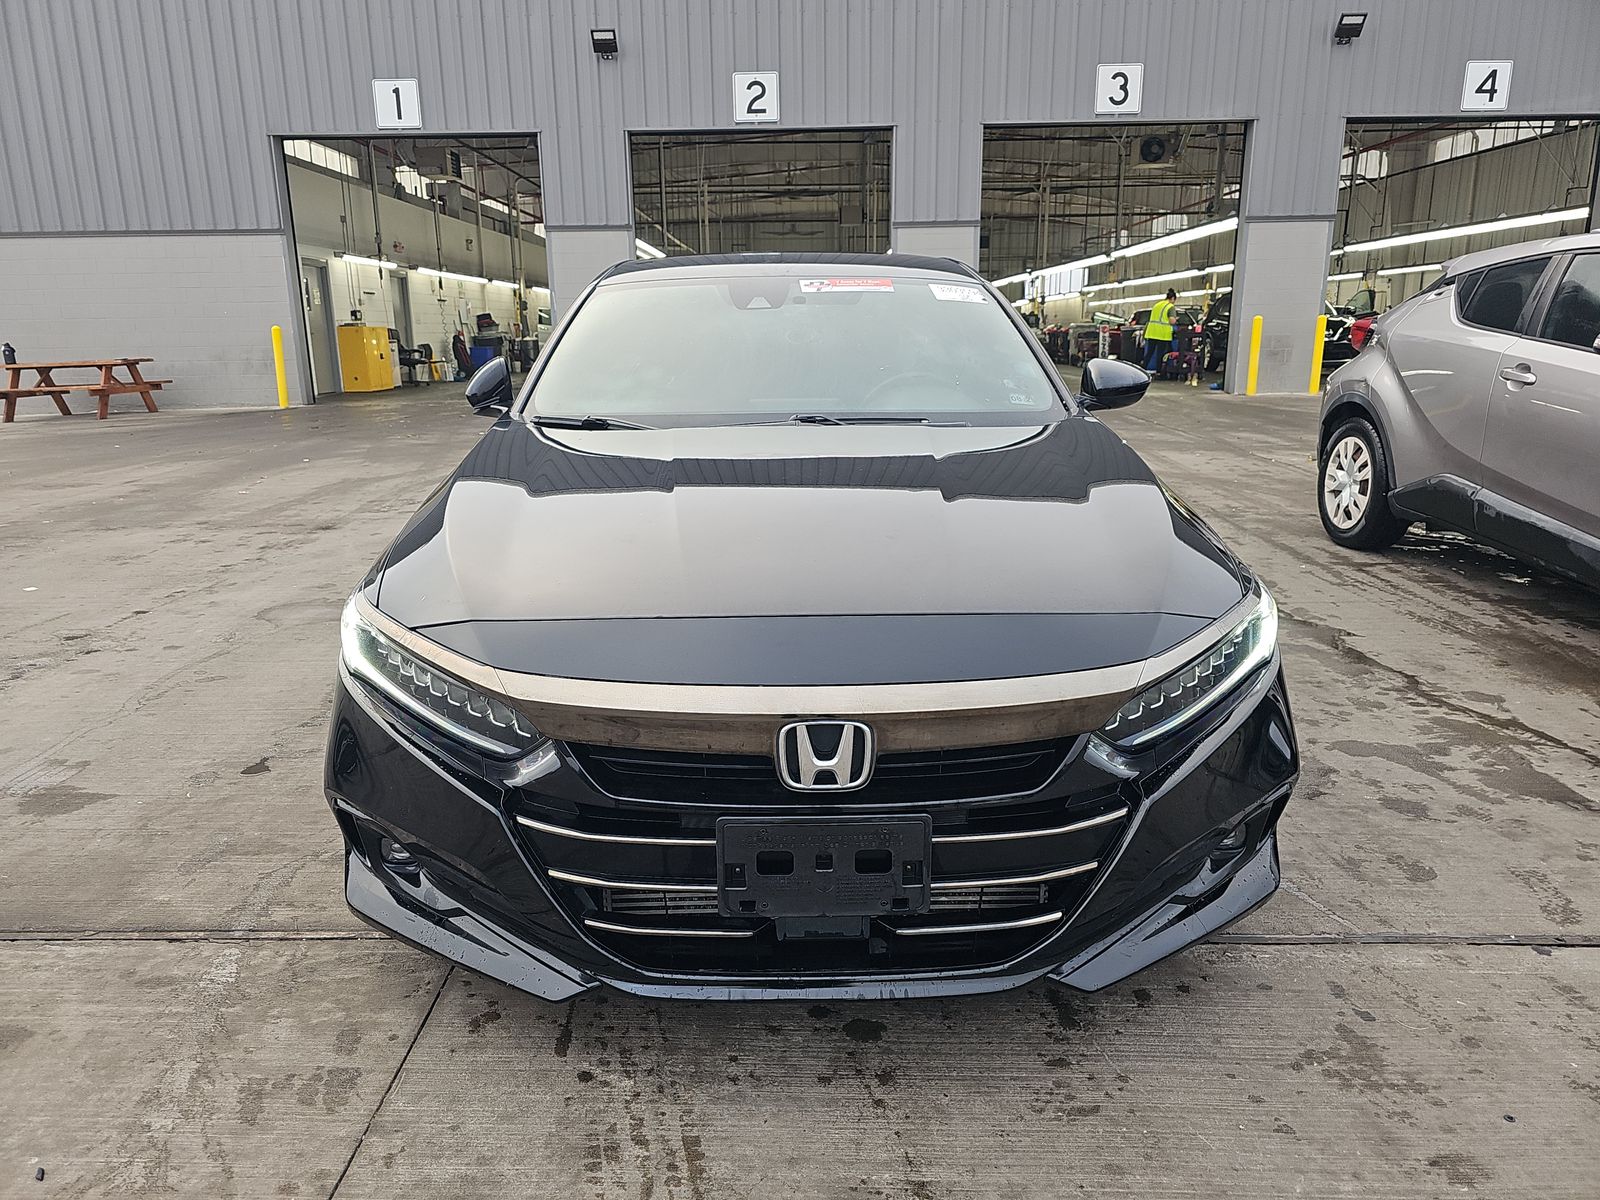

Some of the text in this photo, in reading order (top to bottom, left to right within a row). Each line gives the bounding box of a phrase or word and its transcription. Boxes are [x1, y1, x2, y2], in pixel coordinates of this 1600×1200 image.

[746, 80, 767, 114] 2
[1108, 71, 1129, 106] 3
[1474, 69, 1498, 103] 4
[392, 87, 403, 121] 1
